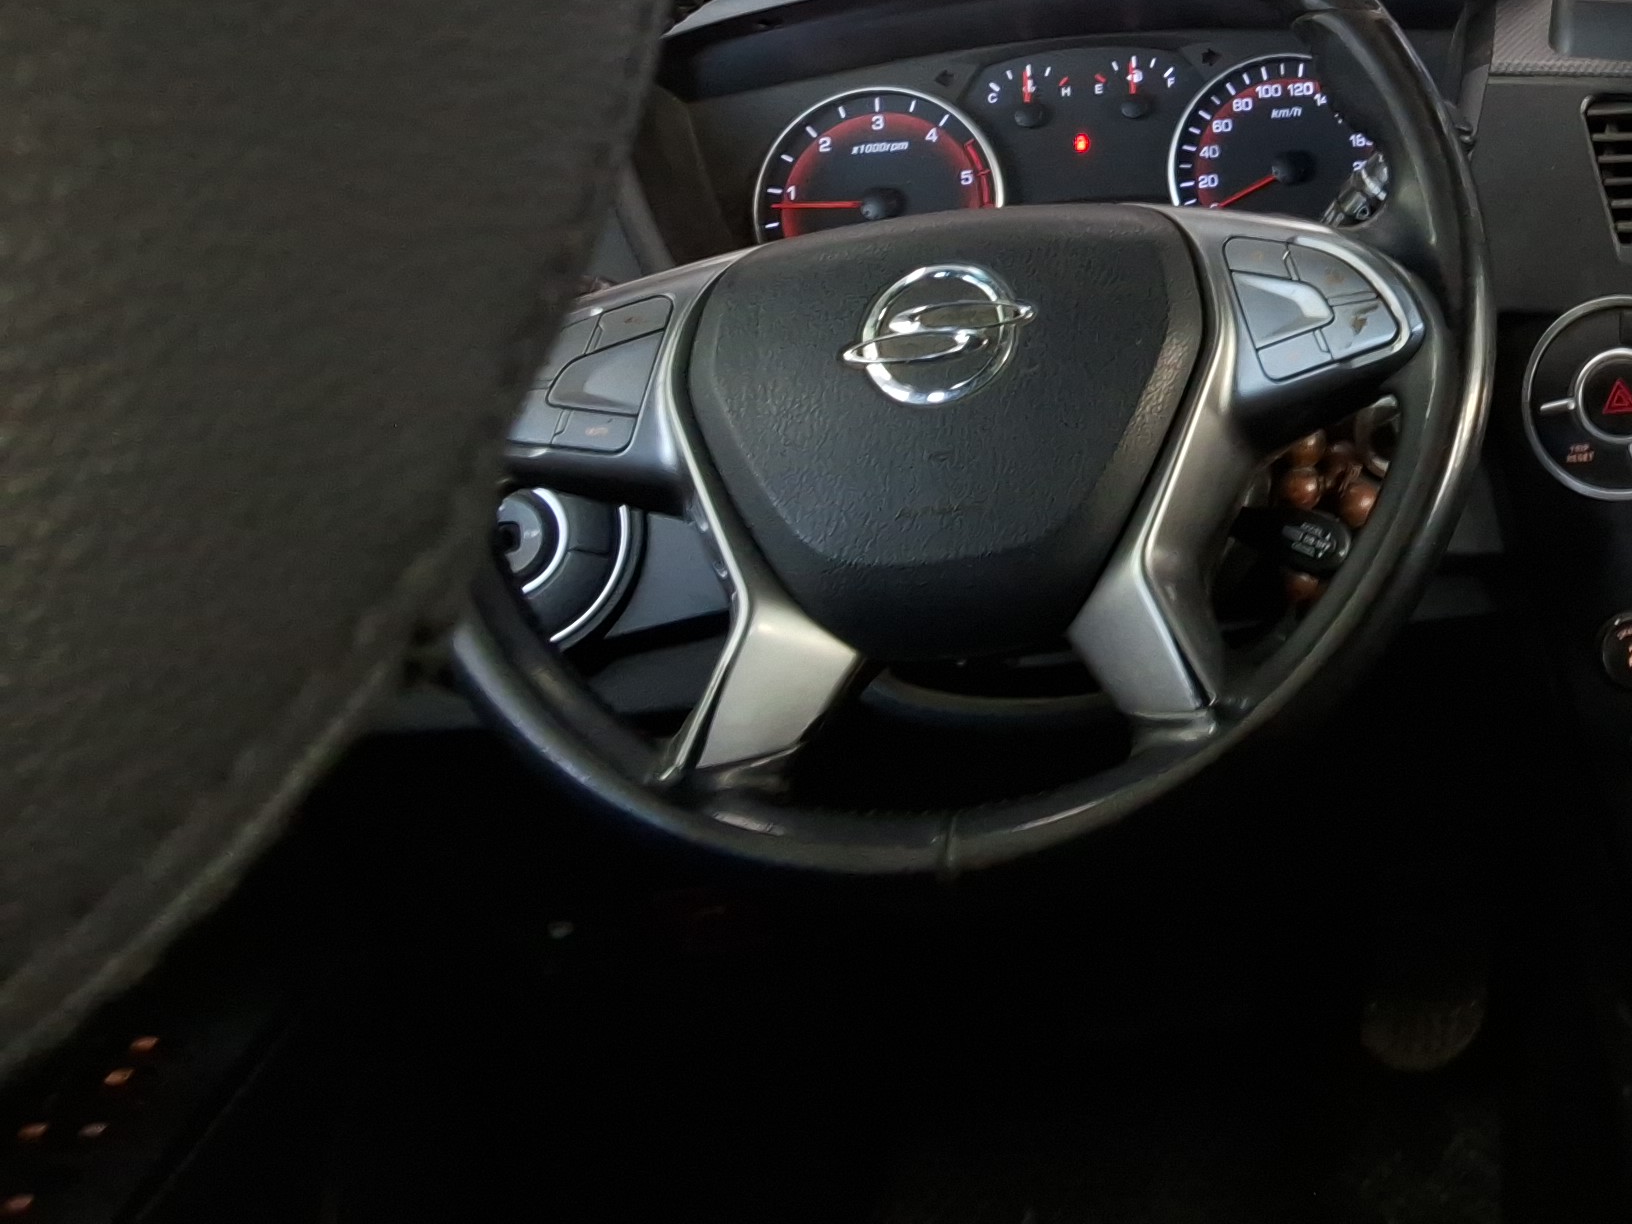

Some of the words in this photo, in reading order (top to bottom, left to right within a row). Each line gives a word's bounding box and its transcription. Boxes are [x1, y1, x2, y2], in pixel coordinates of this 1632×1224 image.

[1094, 83, 1104, 95] E
[1166, 76, 1176, 88] F
[1287, 81, 1314, 97] 120
[987, 92, 999, 104] C
[1061, 87, 1072, 97] H
[1255, 84, 1282, 99] 100
[1232, 98, 1253, 113] 80
[1313, 92, 1327, 107] 14
[1270, 106, 1302, 120] km/h
[871, 114, 885, 131] 3
[1212, 119, 1233, 133] 60
[925, 127, 940, 143] 4
[818, 136, 832, 153] 2
[1199, 144, 1221, 159] 40
[960, 169, 974, 186] 5
[1198, 174, 1219, 189] 20
[786, 185, 797, 201] 1
